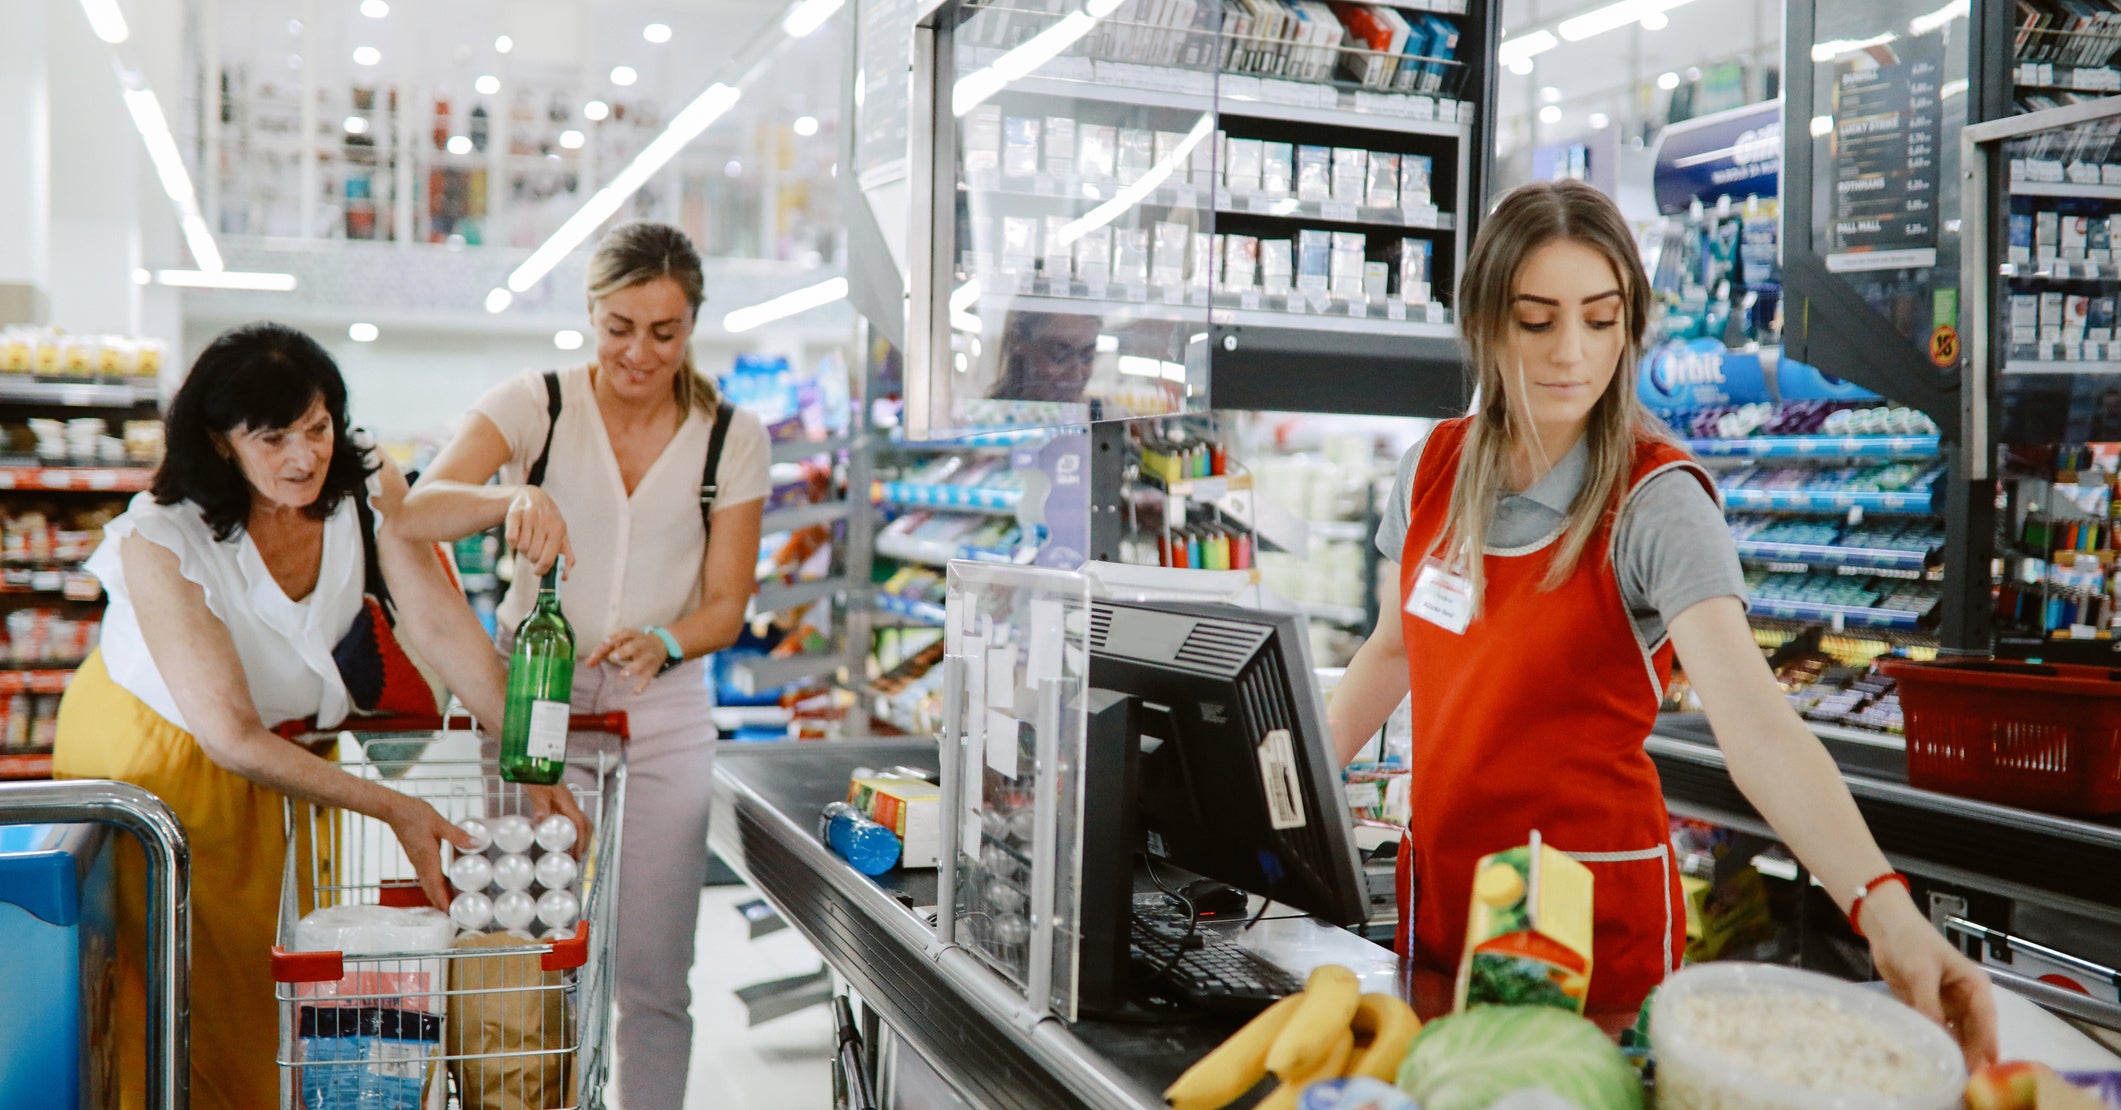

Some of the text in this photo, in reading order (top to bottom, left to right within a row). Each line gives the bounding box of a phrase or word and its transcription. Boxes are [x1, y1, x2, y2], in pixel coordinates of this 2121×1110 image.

[1838, 177, 1885, 193] ROTHMANS
[1836, 219, 1882, 234] PALL MALL
[1661, 350, 1726, 391] Orbit
